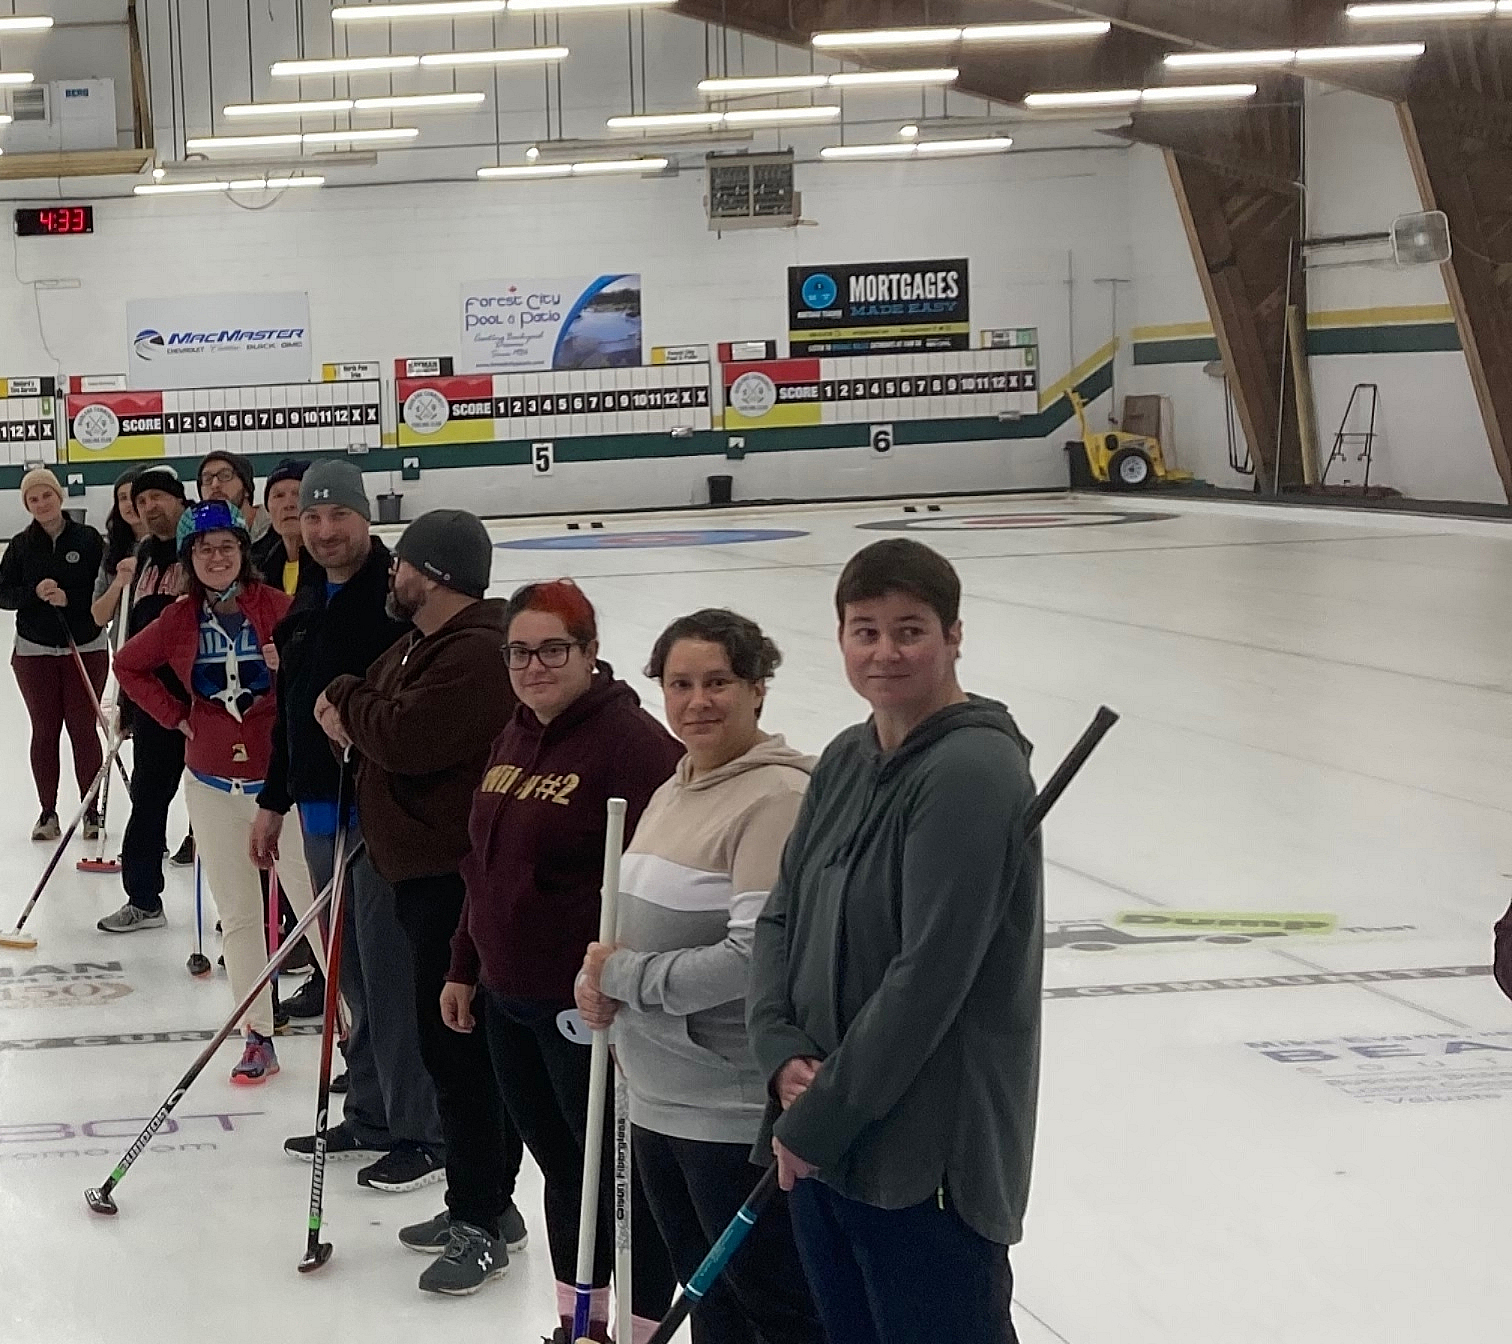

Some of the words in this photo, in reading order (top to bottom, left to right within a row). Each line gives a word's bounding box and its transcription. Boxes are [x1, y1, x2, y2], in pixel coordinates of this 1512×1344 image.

[40, 208, 84, 232] 4:33
[849, 271, 959, 302] MORTGAGES
[465, 295, 523, 314] Forest
[526, 294, 561, 310] City
[849, 304, 905, 316] MADE
[908, 300, 958, 314] EASY
[779, 386, 818, 399] SCORE
[825, 386, 832, 396] 1
[840, 385, 848, 396] 2
[856, 384, 864, 395] 3
[871, 383, 879, 394] 4
[886, 382, 895, 393] 5
[902, 381, 910, 392] 6
[917, 380, 926, 392] 7
[933, 380, 941, 391] 8
[948, 379, 956, 390] 9
[961, 378, 975, 390] 10
[977, 378, 988, 389] 11
[992, 377, 1005, 388] 12
[1009, 376, 1018, 387] X
[1025, 375, 1033, 386] X
[452, 403, 491, 416] SCORE
[498, 402, 505, 413] 1
[513, 401, 521, 412] 2
[528, 401, 536, 412] 3
[543, 400, 552, 411] 4
[559, 399, 567, 410] 5
[574, 398, 582, 409] 6
[589, 397, 598, 408] 7
[605, 396, 613, 407] 8
[620, 396, 628, 407] 9
[633, 395, 647, 406] 10
[649, 394, 661, 405] 11
[664, 393, 678, 404] 12
[682, 392, 690, 403] X
[697, 391, 706, 402] X
[10, 426, 24, 437] 12
[28, 425, 37, 436] X
[43, 424, 52, 436] X
[122, 418, 161, 432] SCORE
[168, 418, 174, 429] 1
[183, 418, 192, 428] 2
[198, 417, 207, 428] 3
[213, 416, 222, 427] 4
[229, 415, 237, 426] 5
[244, 414, 253, 425] 6
[260, 414, 268, 425] 7
[276, 413, 284, 424] 8
[291, 412, 299, 424] 9
[304, 412, 317, 422] 10
[320, 411, 331, 422] 11
[335, 410, 348, 422] 12
[352, 410, 361, 420] X
[367, 409, 376, 420] X
[872, 430, 891, 452] 6
[536, 447, 549, 472] 5
